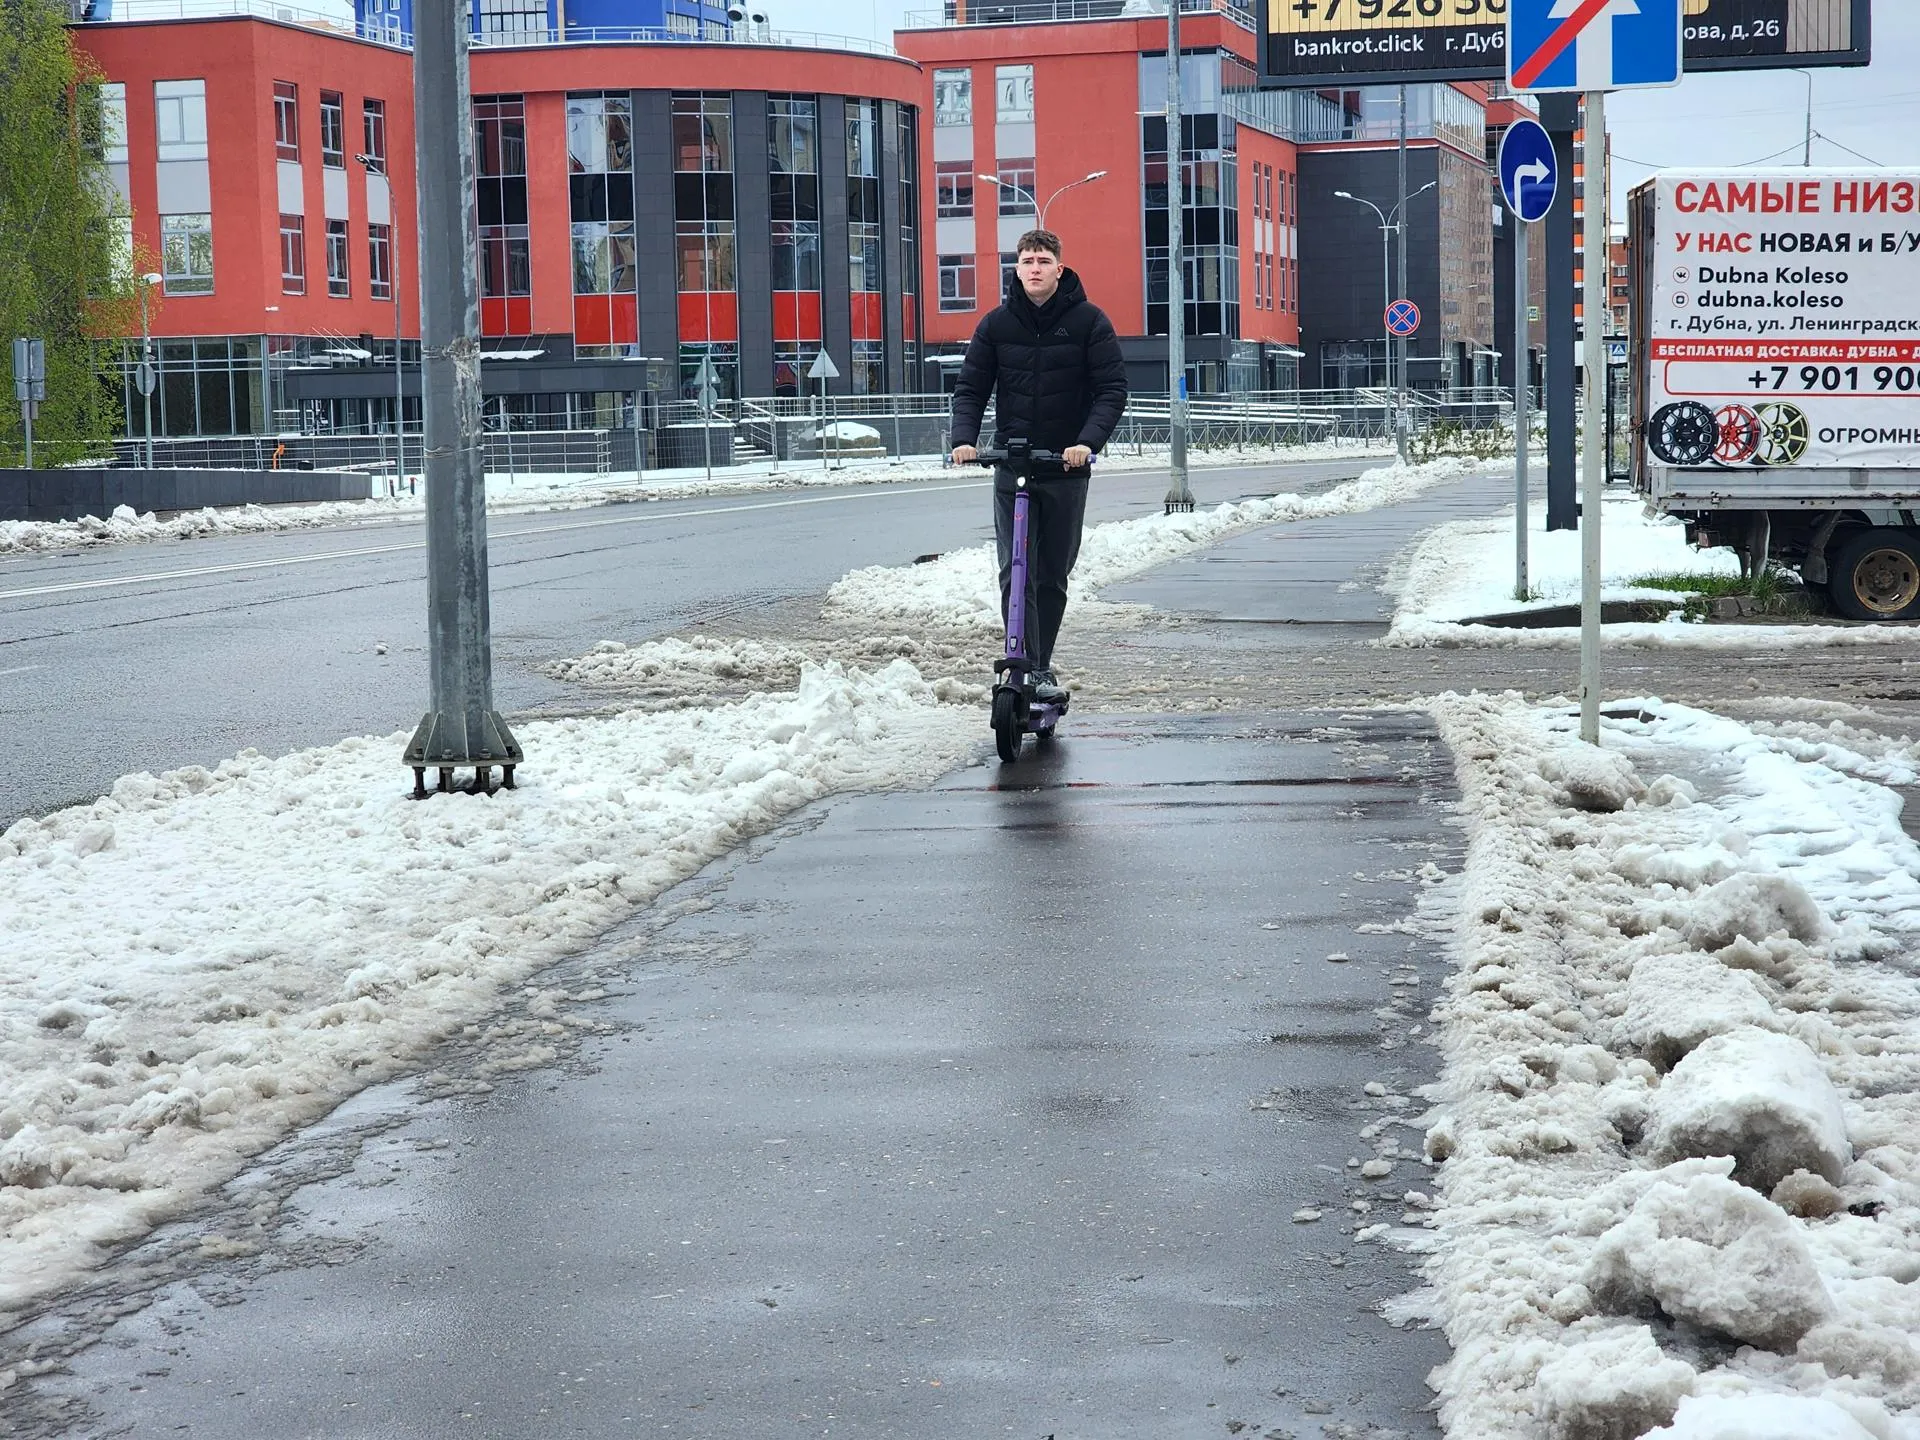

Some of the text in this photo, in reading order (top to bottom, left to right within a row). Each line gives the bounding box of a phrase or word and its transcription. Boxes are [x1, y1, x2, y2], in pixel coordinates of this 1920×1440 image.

[1294, 34, 1424, 56] bankrot.click
[1446, 38, 1458, 51] г.
[1731, 25, 1750, 40] д.
[1753, 20, 1779, 37] 26
[1675, 181, 1920, 213] САМЫЕ НИЗ
[1675, 230, 1920, 255] У НАС НОВАЯ и Б/У
[1698, 266, 1768, 284] Dubna
[1776, 266, 1849, 284] Koleso
[1697, 290, 1844, 308] dubna.koleso
[1670, 315, 1920, 334] г. Дубна, ул. Ленинградск
[1658, 345, 1753, 357] БЕСПЛАТНАЯ
[1757, 346, 1844, 358] ДОСТАВКА:
[1847, 346, 1898, 359] ДУБНА
[1748, 366, 1920, 391] +7 901 90
